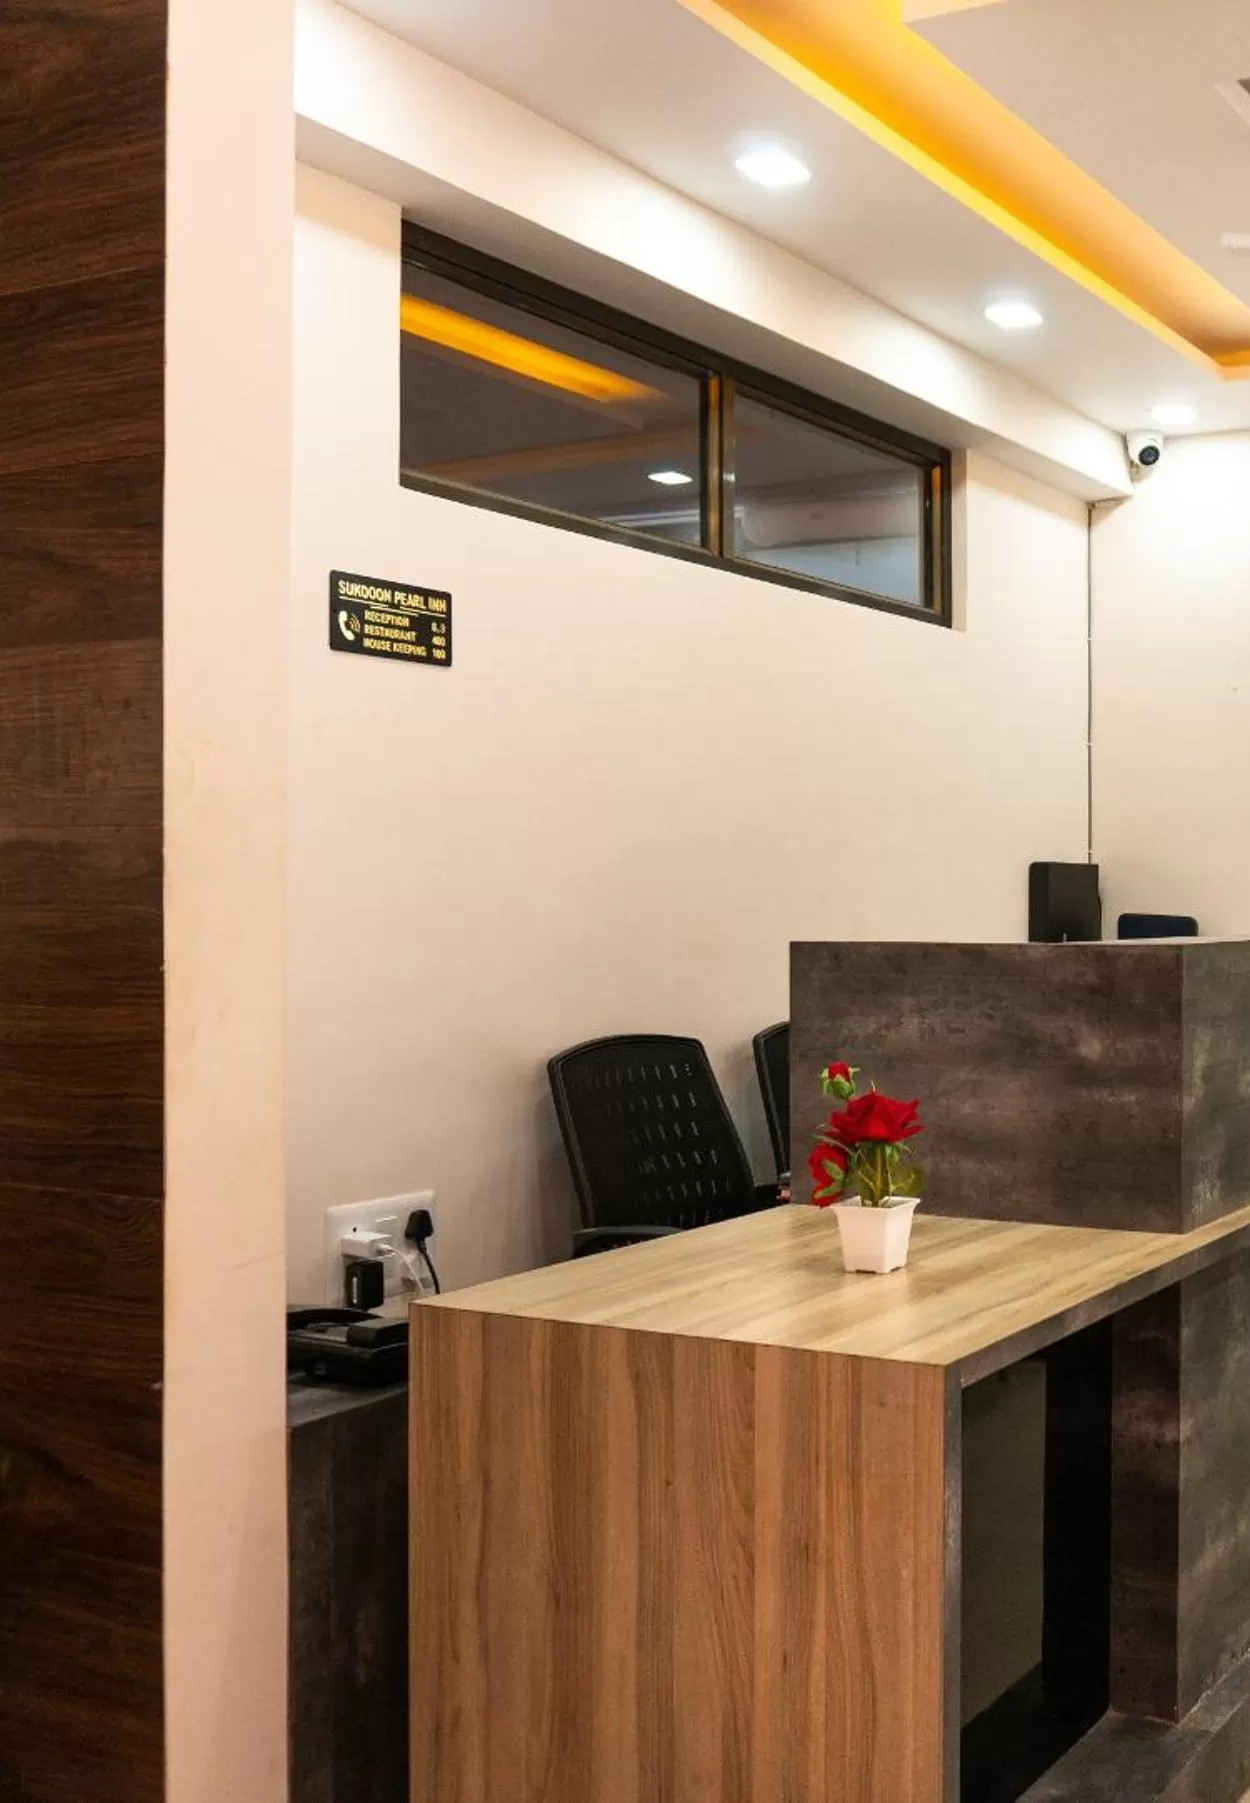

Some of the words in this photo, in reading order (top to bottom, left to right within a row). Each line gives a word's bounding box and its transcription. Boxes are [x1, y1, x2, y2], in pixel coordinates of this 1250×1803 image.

[394, 591, 427, 608] PEARL
[428, 597, 446, 612] INN
[364, 610, 409, 627] RECEPTION
[364, 624, 416, 642] RESTAURANT
[363, 638, 392, 652] HOUSE
[393, 644, 427, 656] KEEPING
